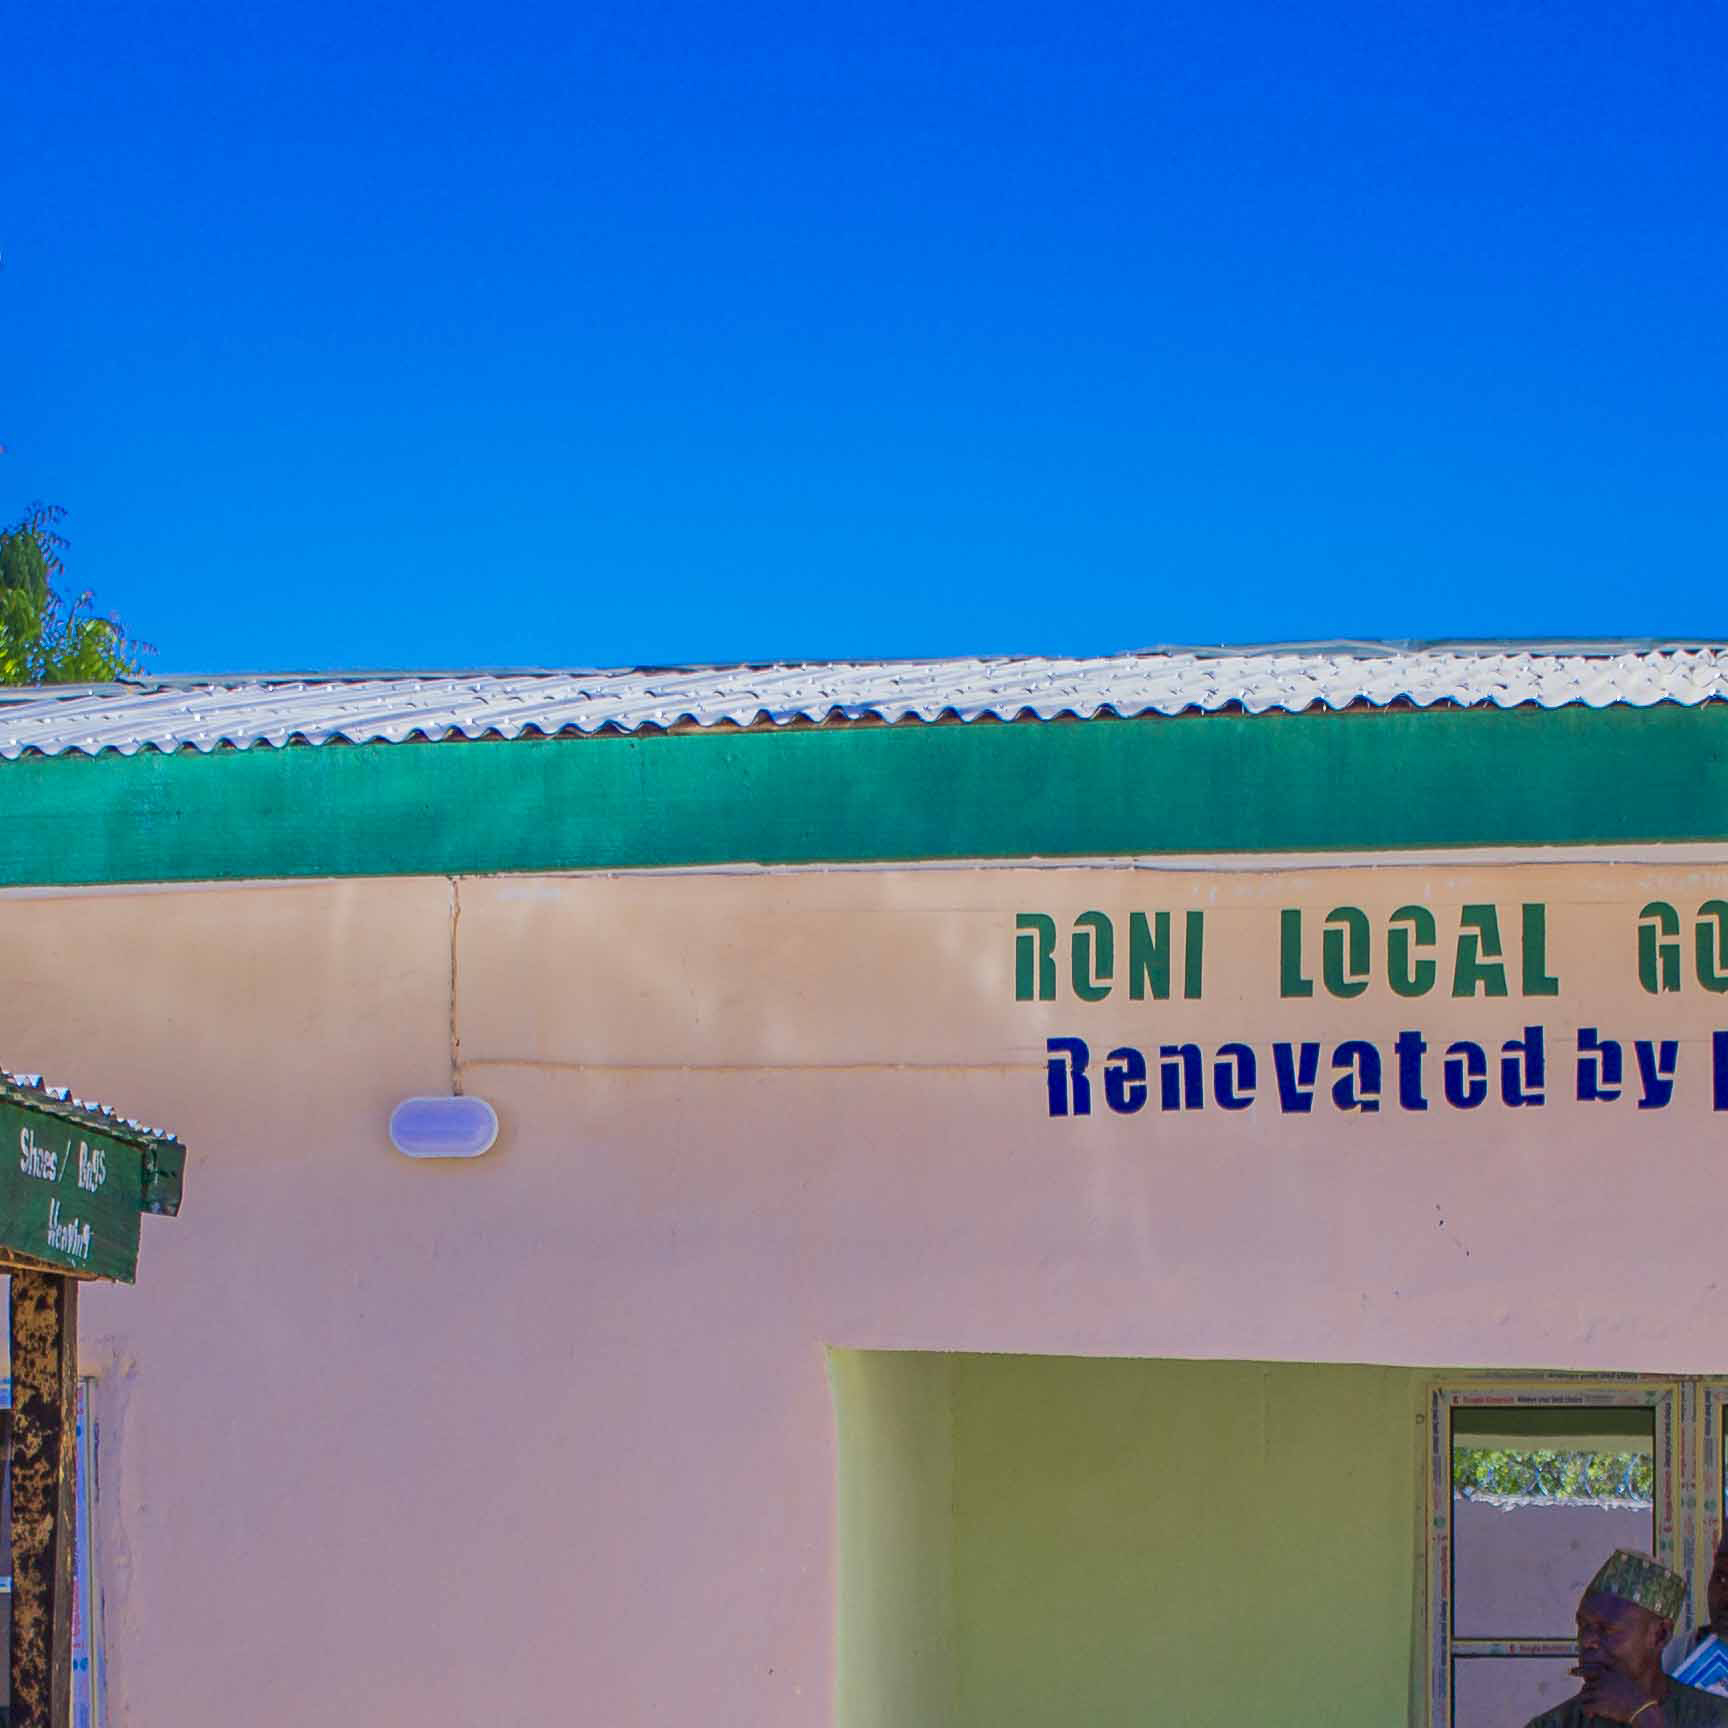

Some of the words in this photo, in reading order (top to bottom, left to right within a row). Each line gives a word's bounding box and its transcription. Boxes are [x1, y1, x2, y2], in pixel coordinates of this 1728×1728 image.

[1015, 910, 1204, 1001] RONI
[1281, 903, 1559, 998] LOCAL
[1046, 1025, 1545, 1117] Renovated
[1576, 1026, 1679, 1110] by
